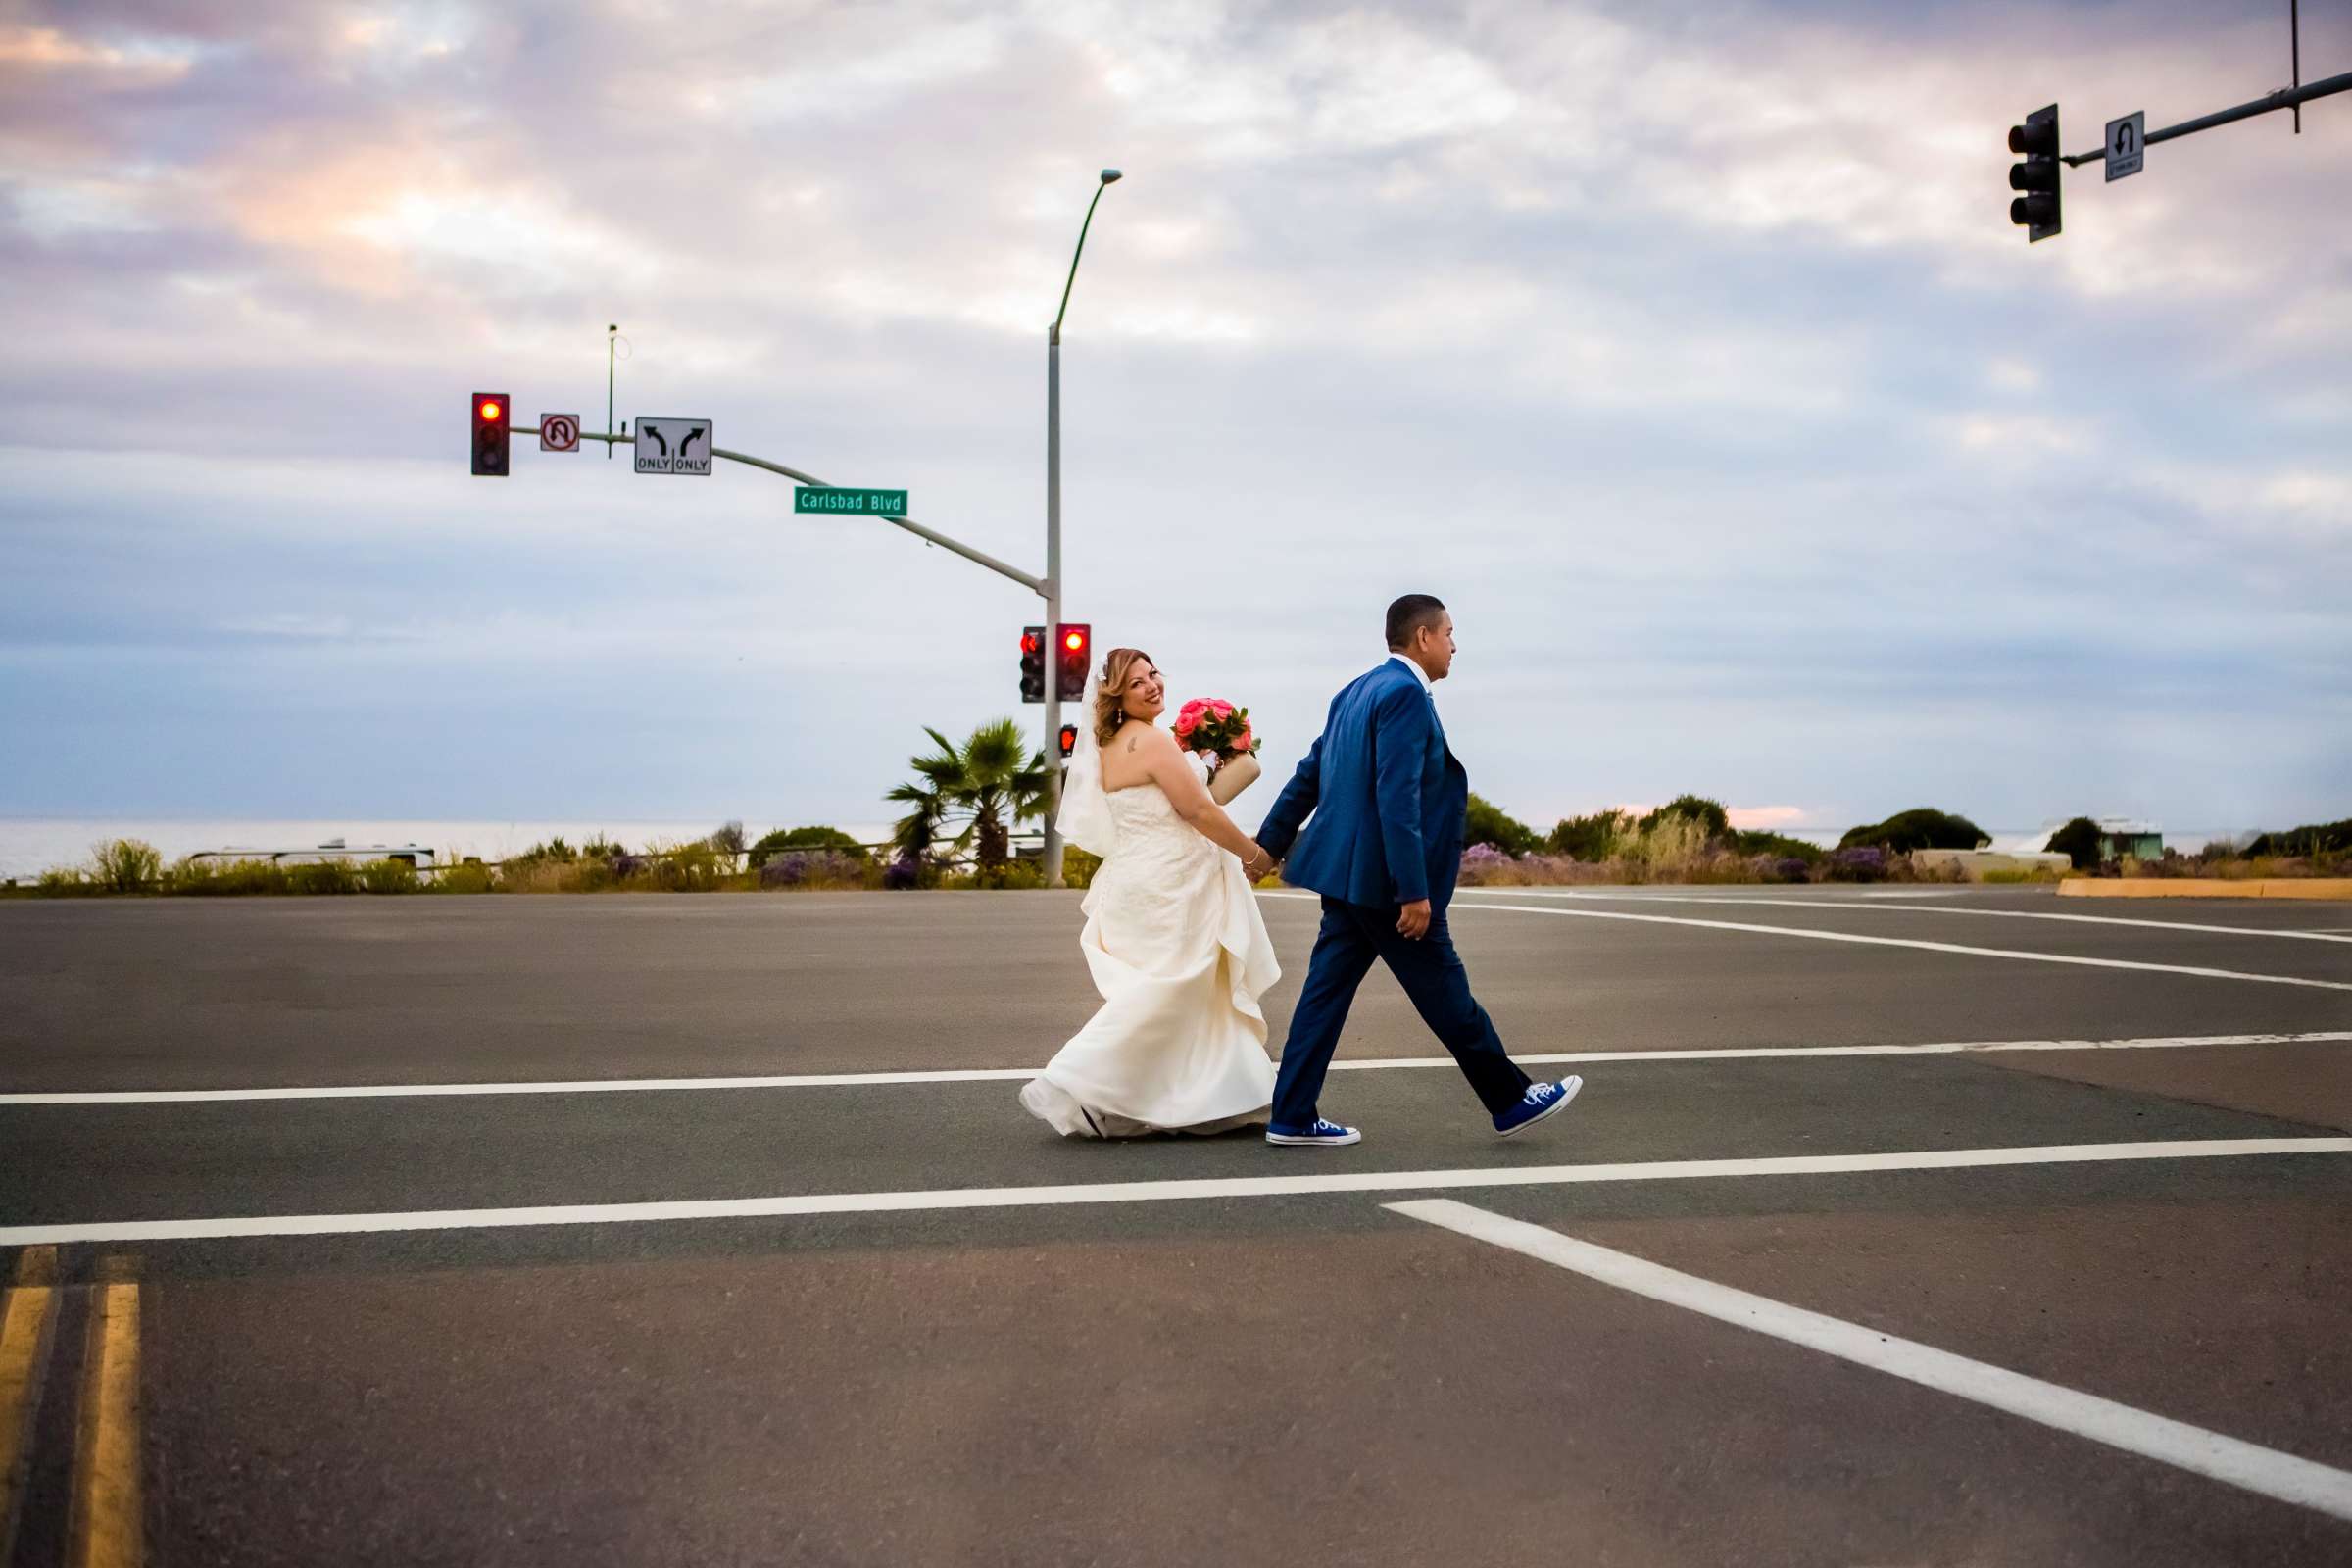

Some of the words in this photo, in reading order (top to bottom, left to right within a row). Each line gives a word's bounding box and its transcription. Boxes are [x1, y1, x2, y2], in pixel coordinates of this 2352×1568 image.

[638, 458, 670, 469] ONLY
[675, 459, 708, 471] ONLY
[801, 493, 863, 510] Carlsbad
[871, 495, 901, 511] Blvd
